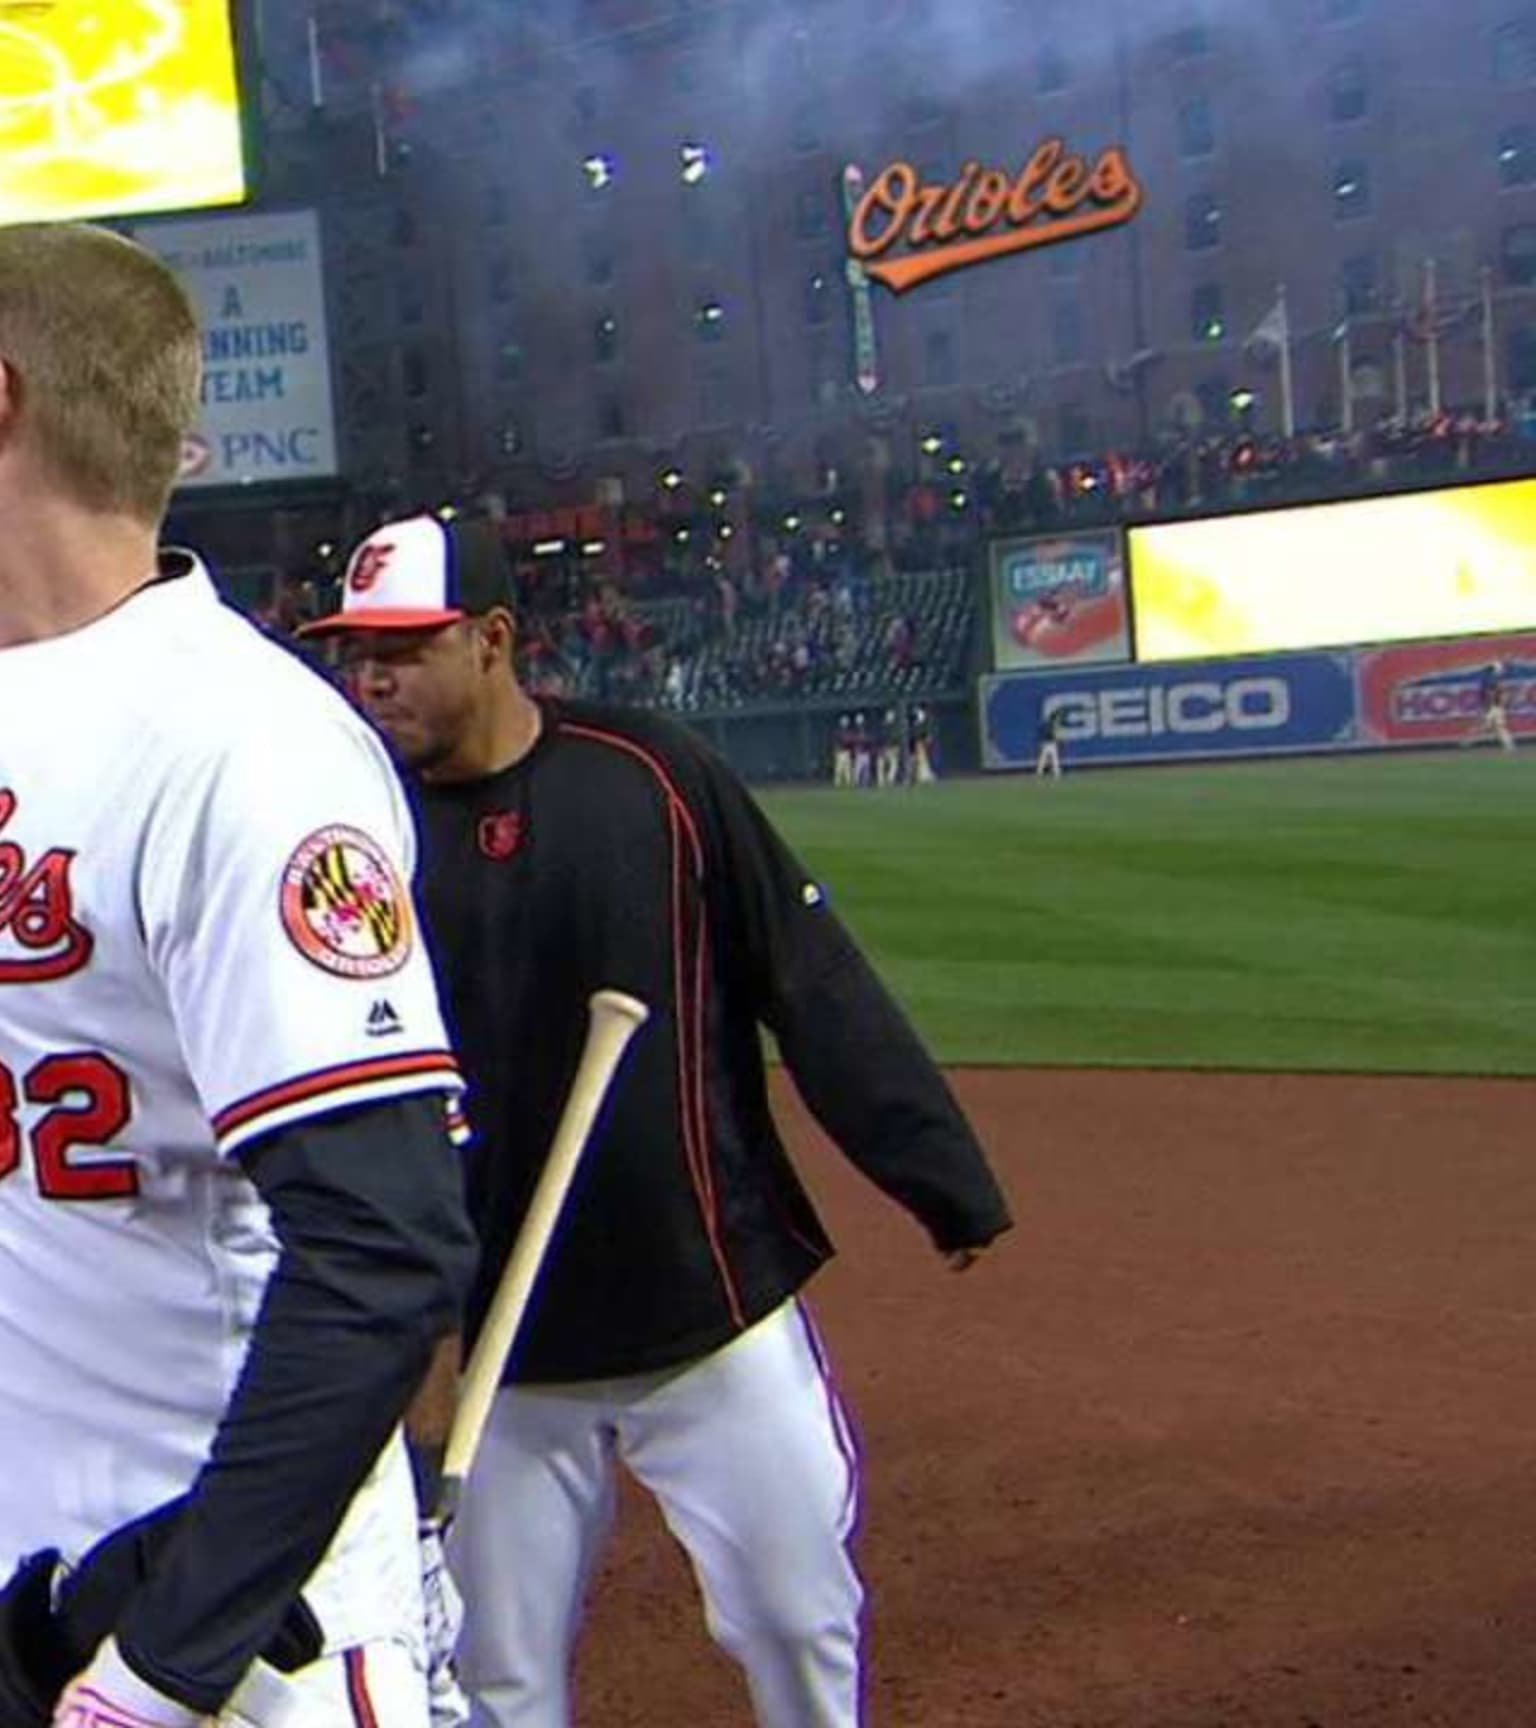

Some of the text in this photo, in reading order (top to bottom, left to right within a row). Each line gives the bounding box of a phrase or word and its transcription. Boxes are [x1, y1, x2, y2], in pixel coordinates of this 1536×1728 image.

[849, 138, 1144, 262] Orioles
[221, 285, 244, 318] A
[202, 319, 308, 361] NNING
[221, 426, 319, 469] PNC
[1041, 676, 1290, 742] GEICO
